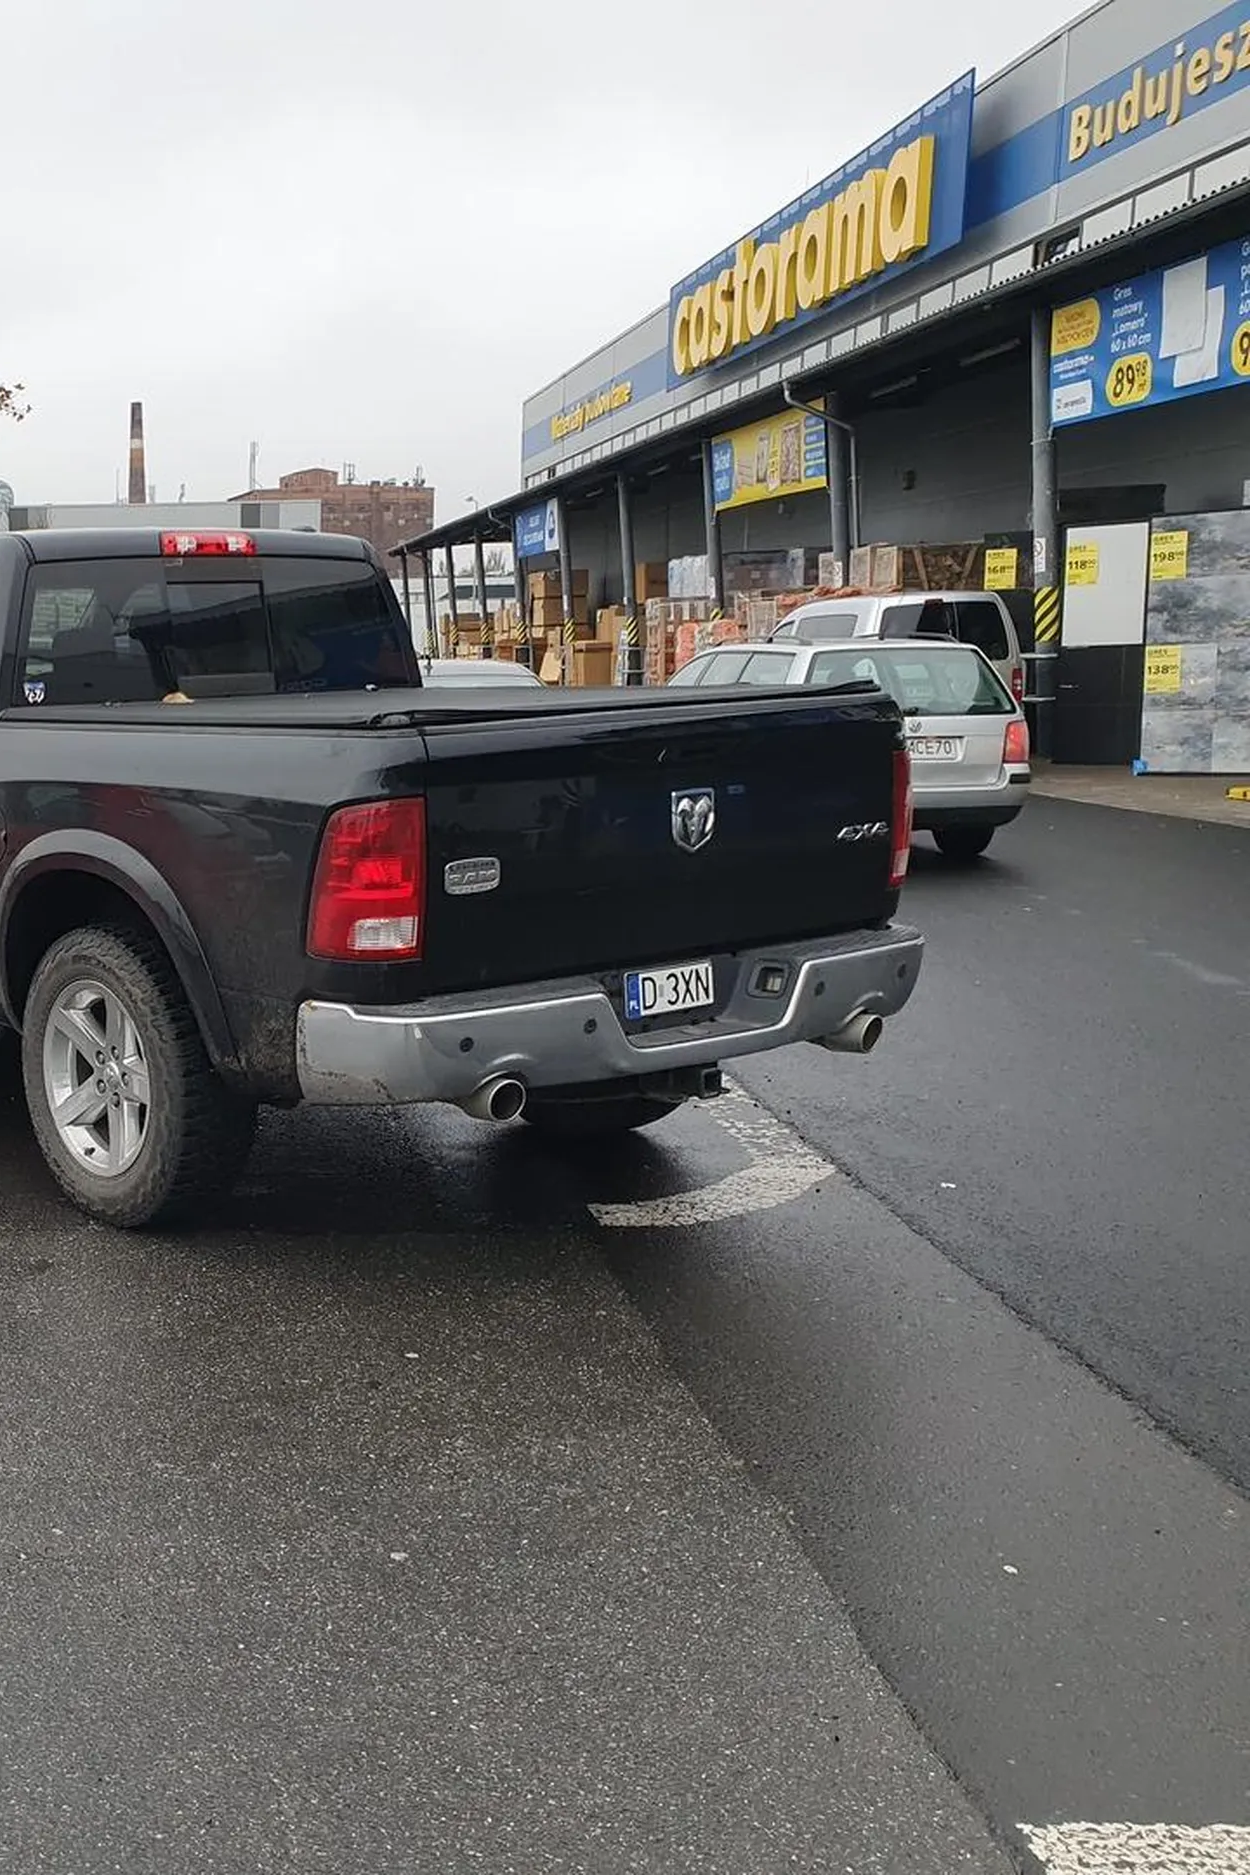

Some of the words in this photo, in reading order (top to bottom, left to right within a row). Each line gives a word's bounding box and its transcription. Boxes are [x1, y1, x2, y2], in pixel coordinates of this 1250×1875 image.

[673, 133, 936, 377] castorama
[641, 976, 657, 1011] D
[666, 966, 710, 1006] 3XN
